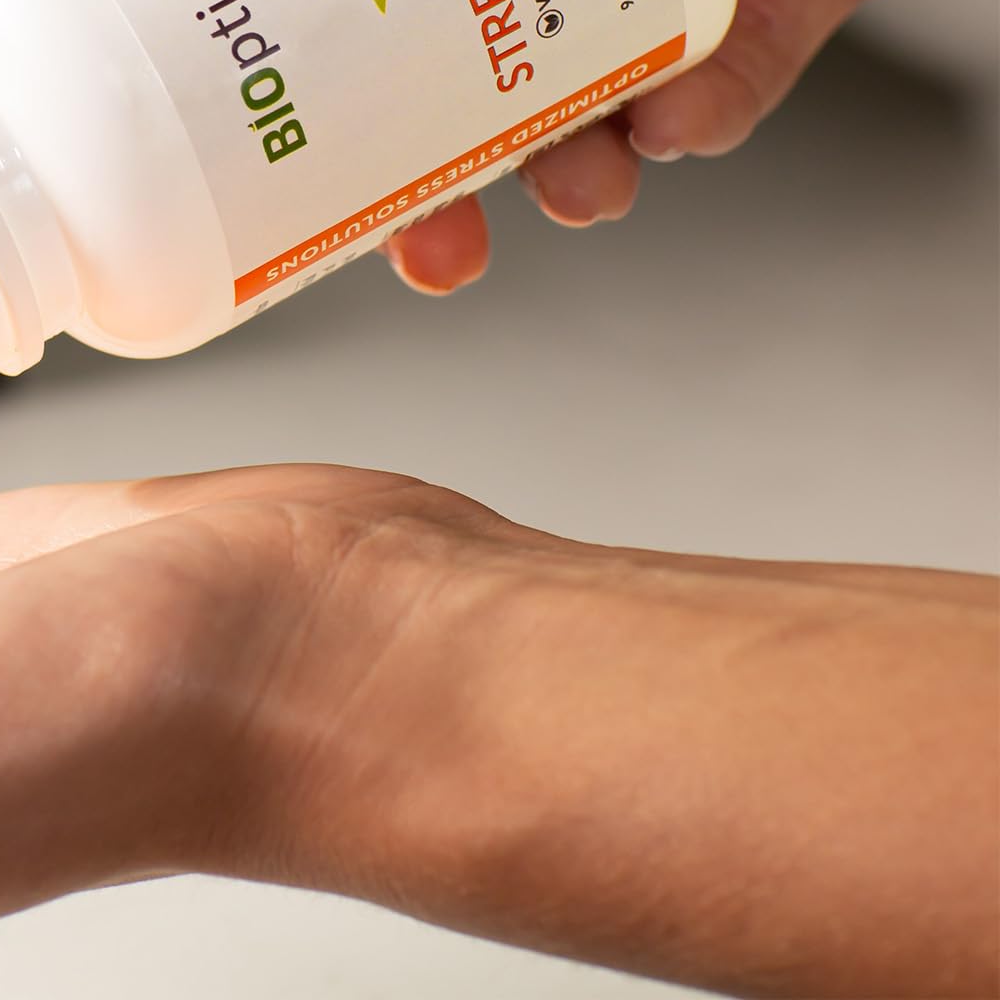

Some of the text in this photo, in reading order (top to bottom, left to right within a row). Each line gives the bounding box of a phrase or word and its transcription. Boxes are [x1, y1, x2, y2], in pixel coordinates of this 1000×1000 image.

[266, 63, 648, 282] OPTIMIZED STRESS SOLUTIONS
